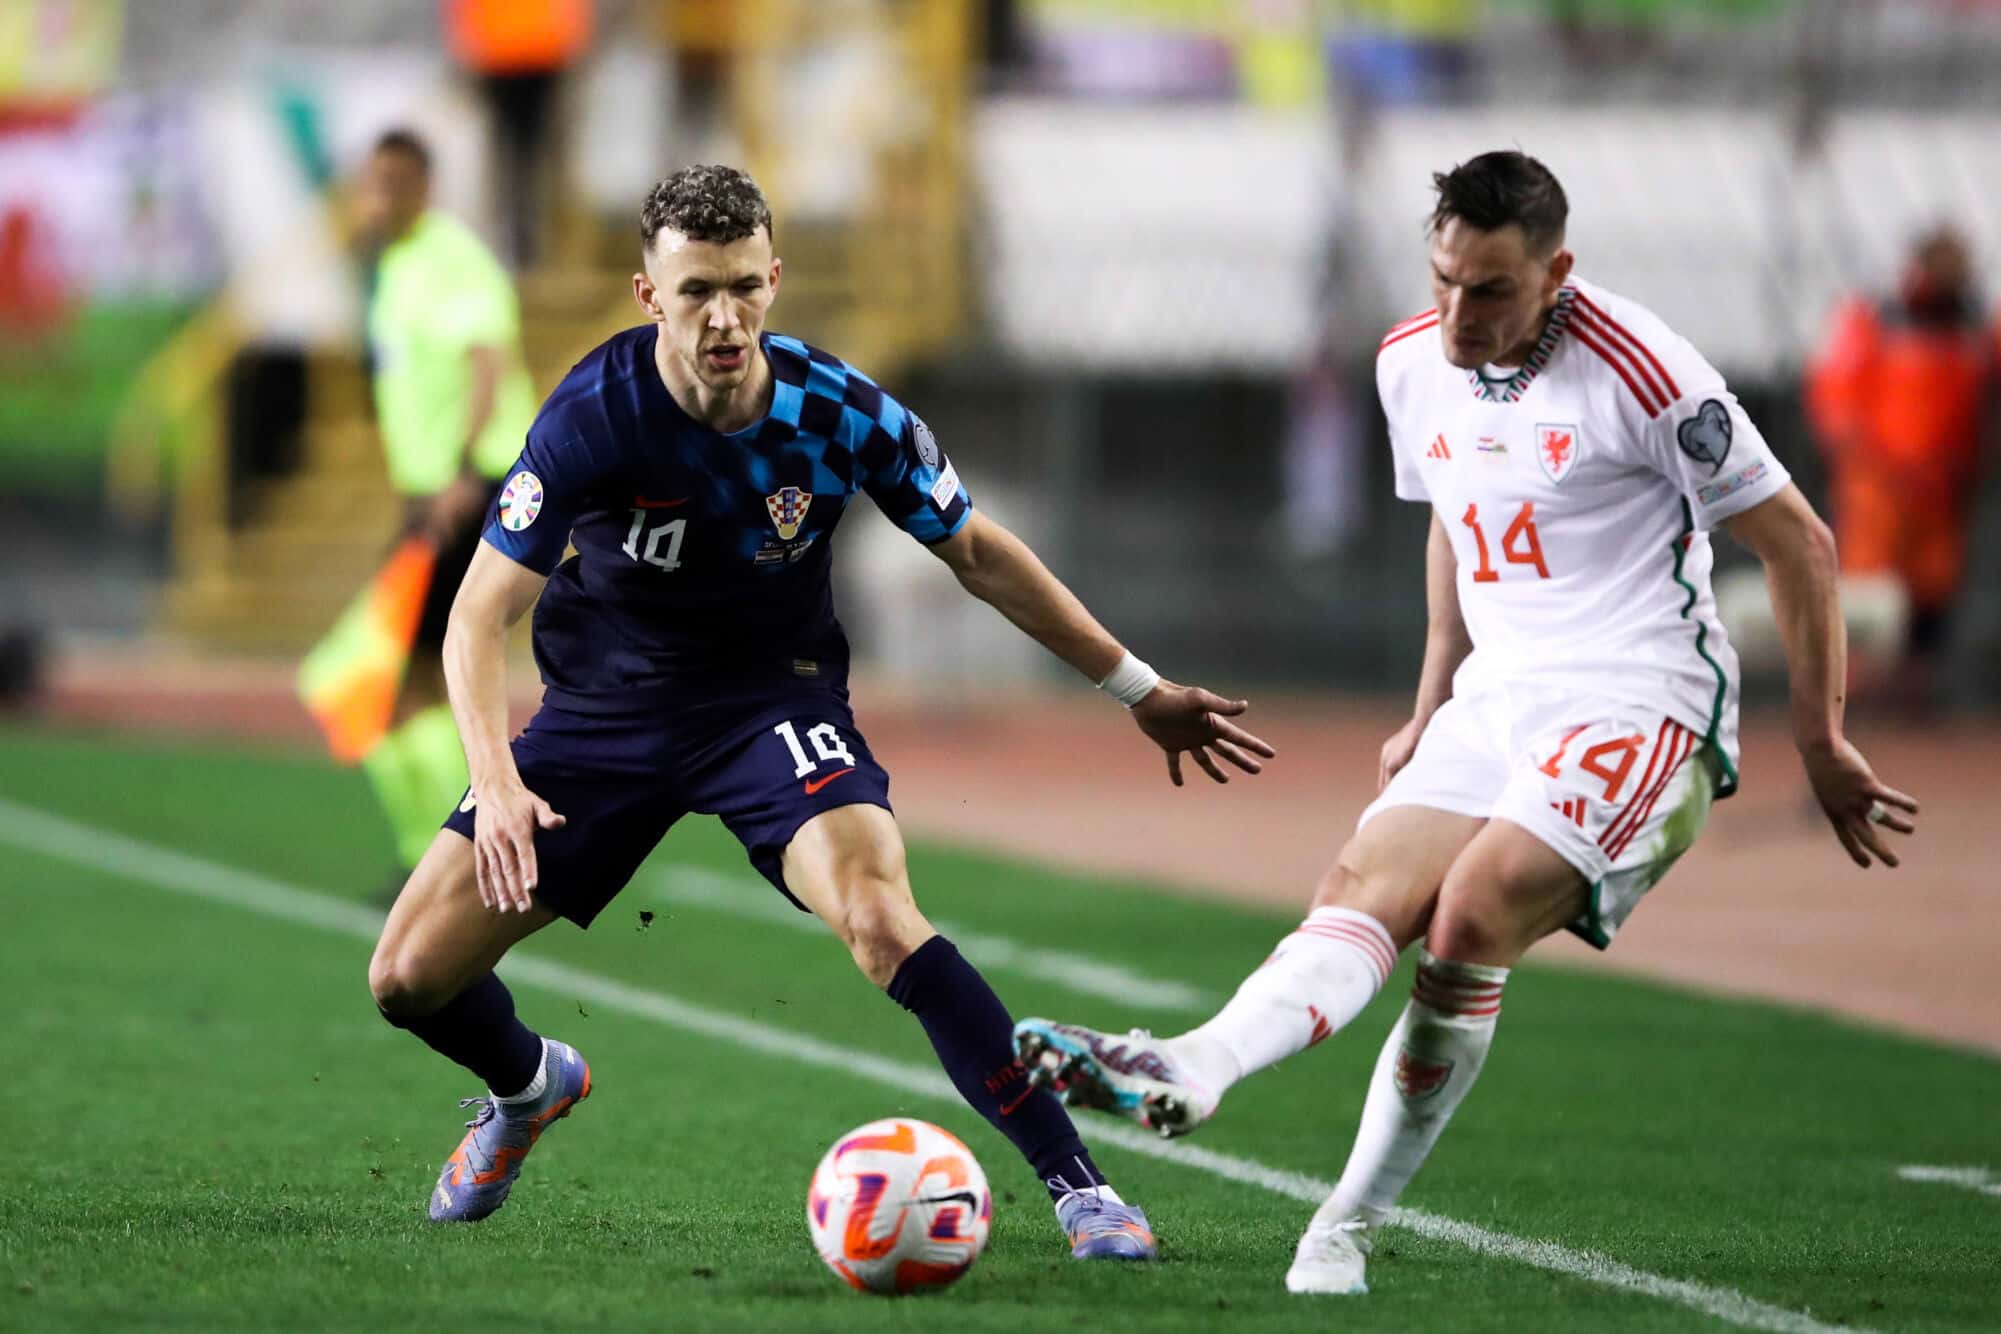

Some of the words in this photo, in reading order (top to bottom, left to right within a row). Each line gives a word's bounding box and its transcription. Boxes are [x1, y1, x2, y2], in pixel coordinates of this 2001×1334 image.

[622, 508, 687, 572] 14
[1462, 501, 1551, 582] 14
[773, 720, 856, 779] 14
[1538, 724, 1646, 804] 14
